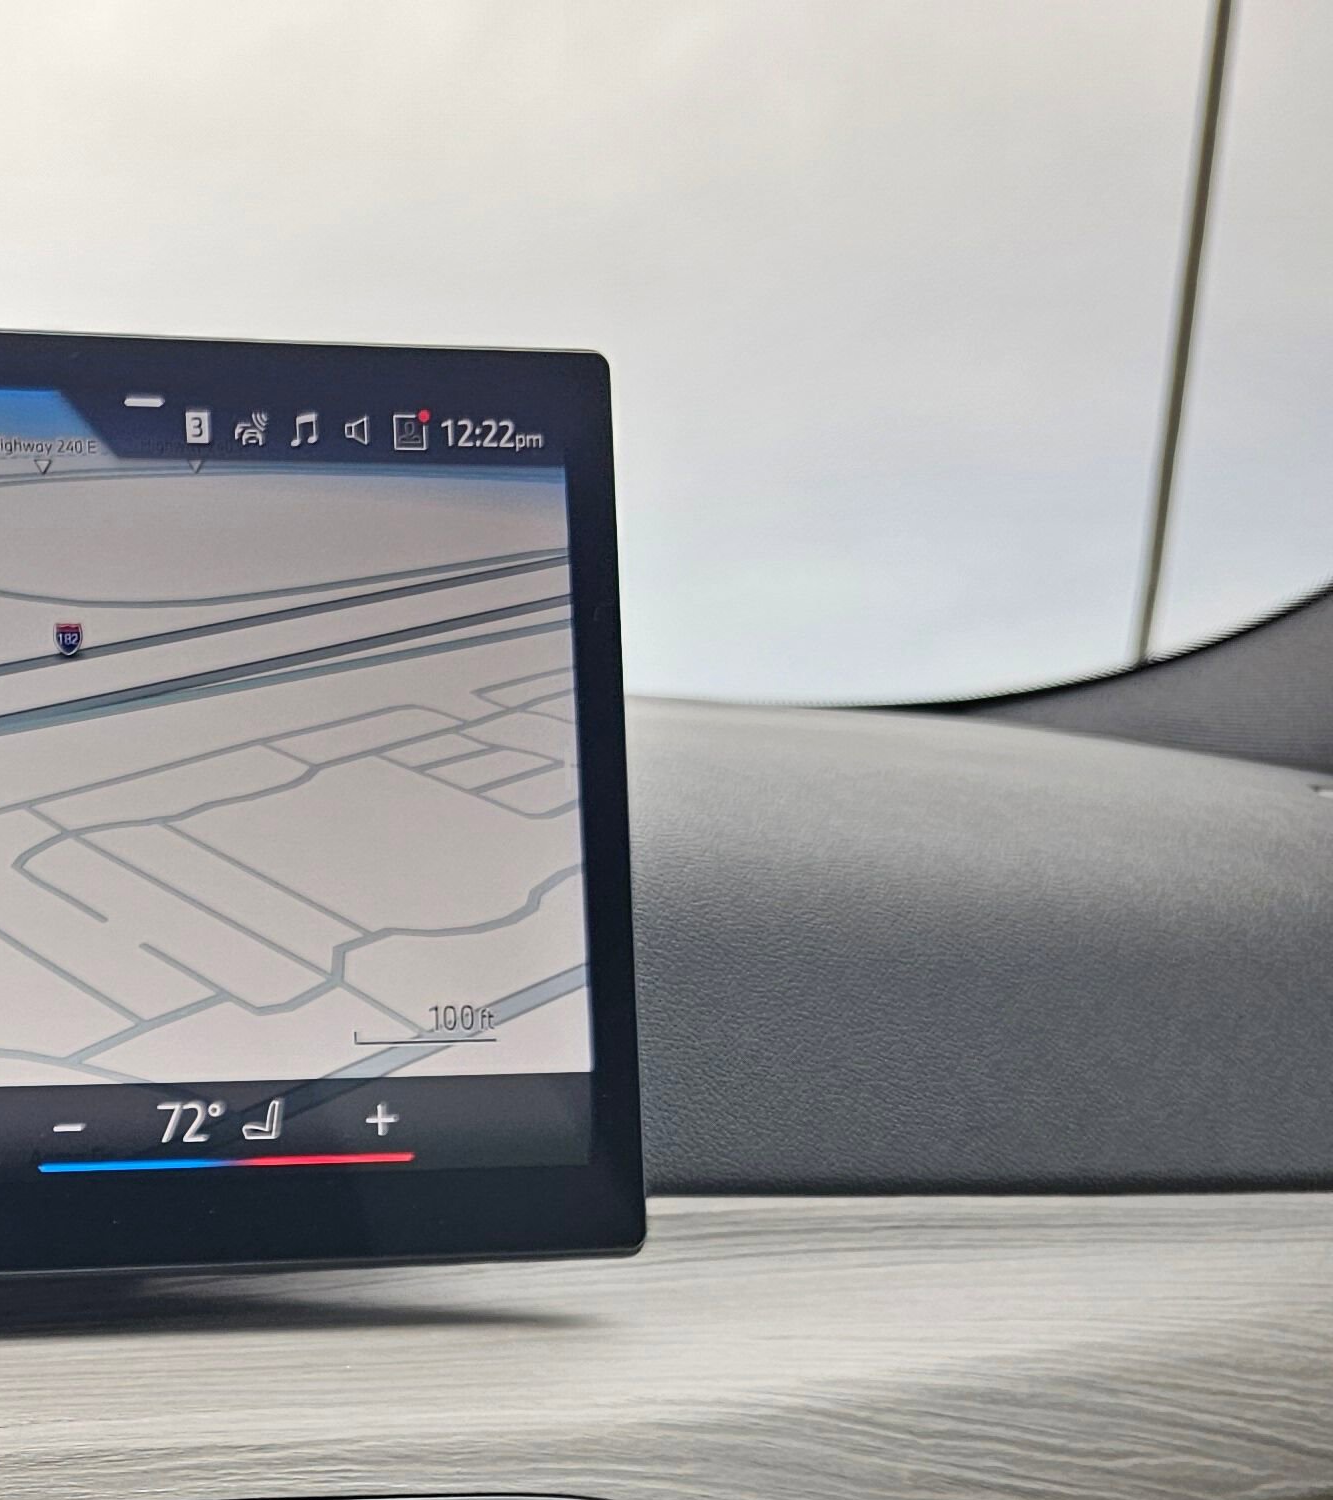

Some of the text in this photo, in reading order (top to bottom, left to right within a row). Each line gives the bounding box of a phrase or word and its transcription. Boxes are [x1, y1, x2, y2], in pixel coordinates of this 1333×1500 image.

[189, 415, 204, 438] 3
[440, 418, 544, 452] 12:22pm
[57, 439, 83, 454] 240
[87, 440, 97, 454] E
[58, 632, 79, 646] 182
